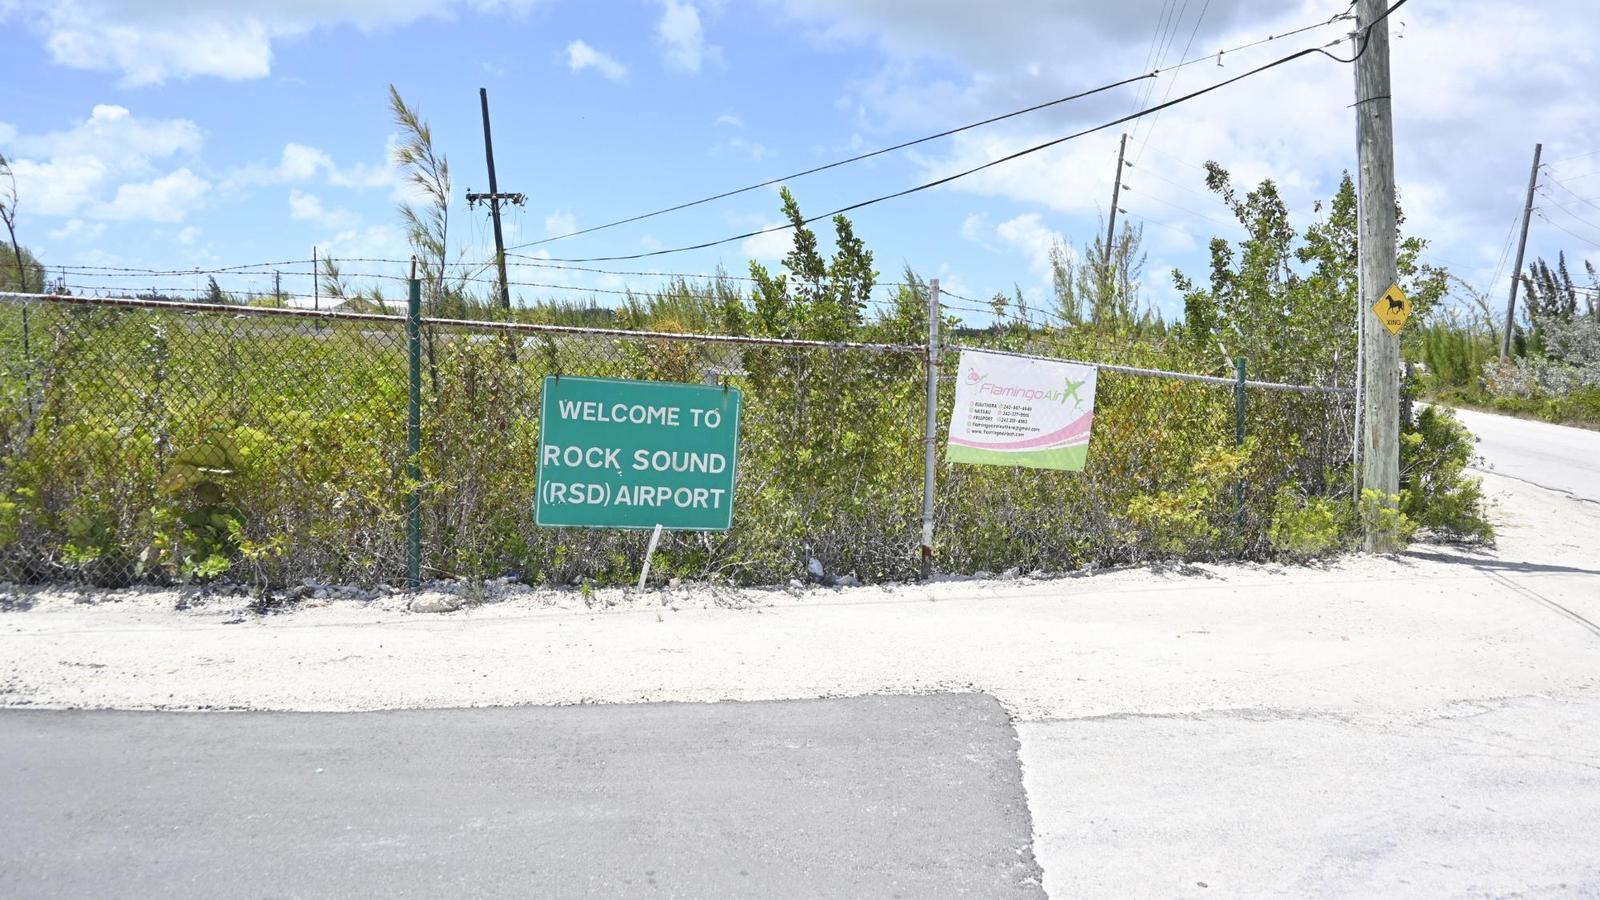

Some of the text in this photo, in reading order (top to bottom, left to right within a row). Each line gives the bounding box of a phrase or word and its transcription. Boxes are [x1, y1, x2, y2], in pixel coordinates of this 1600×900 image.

[558, 400, 721, 428] WELCOME TO
[543, 444, 726, 474] ROCK SOUND
[543, 480, 725, 508] (RSD) AIRPORT
